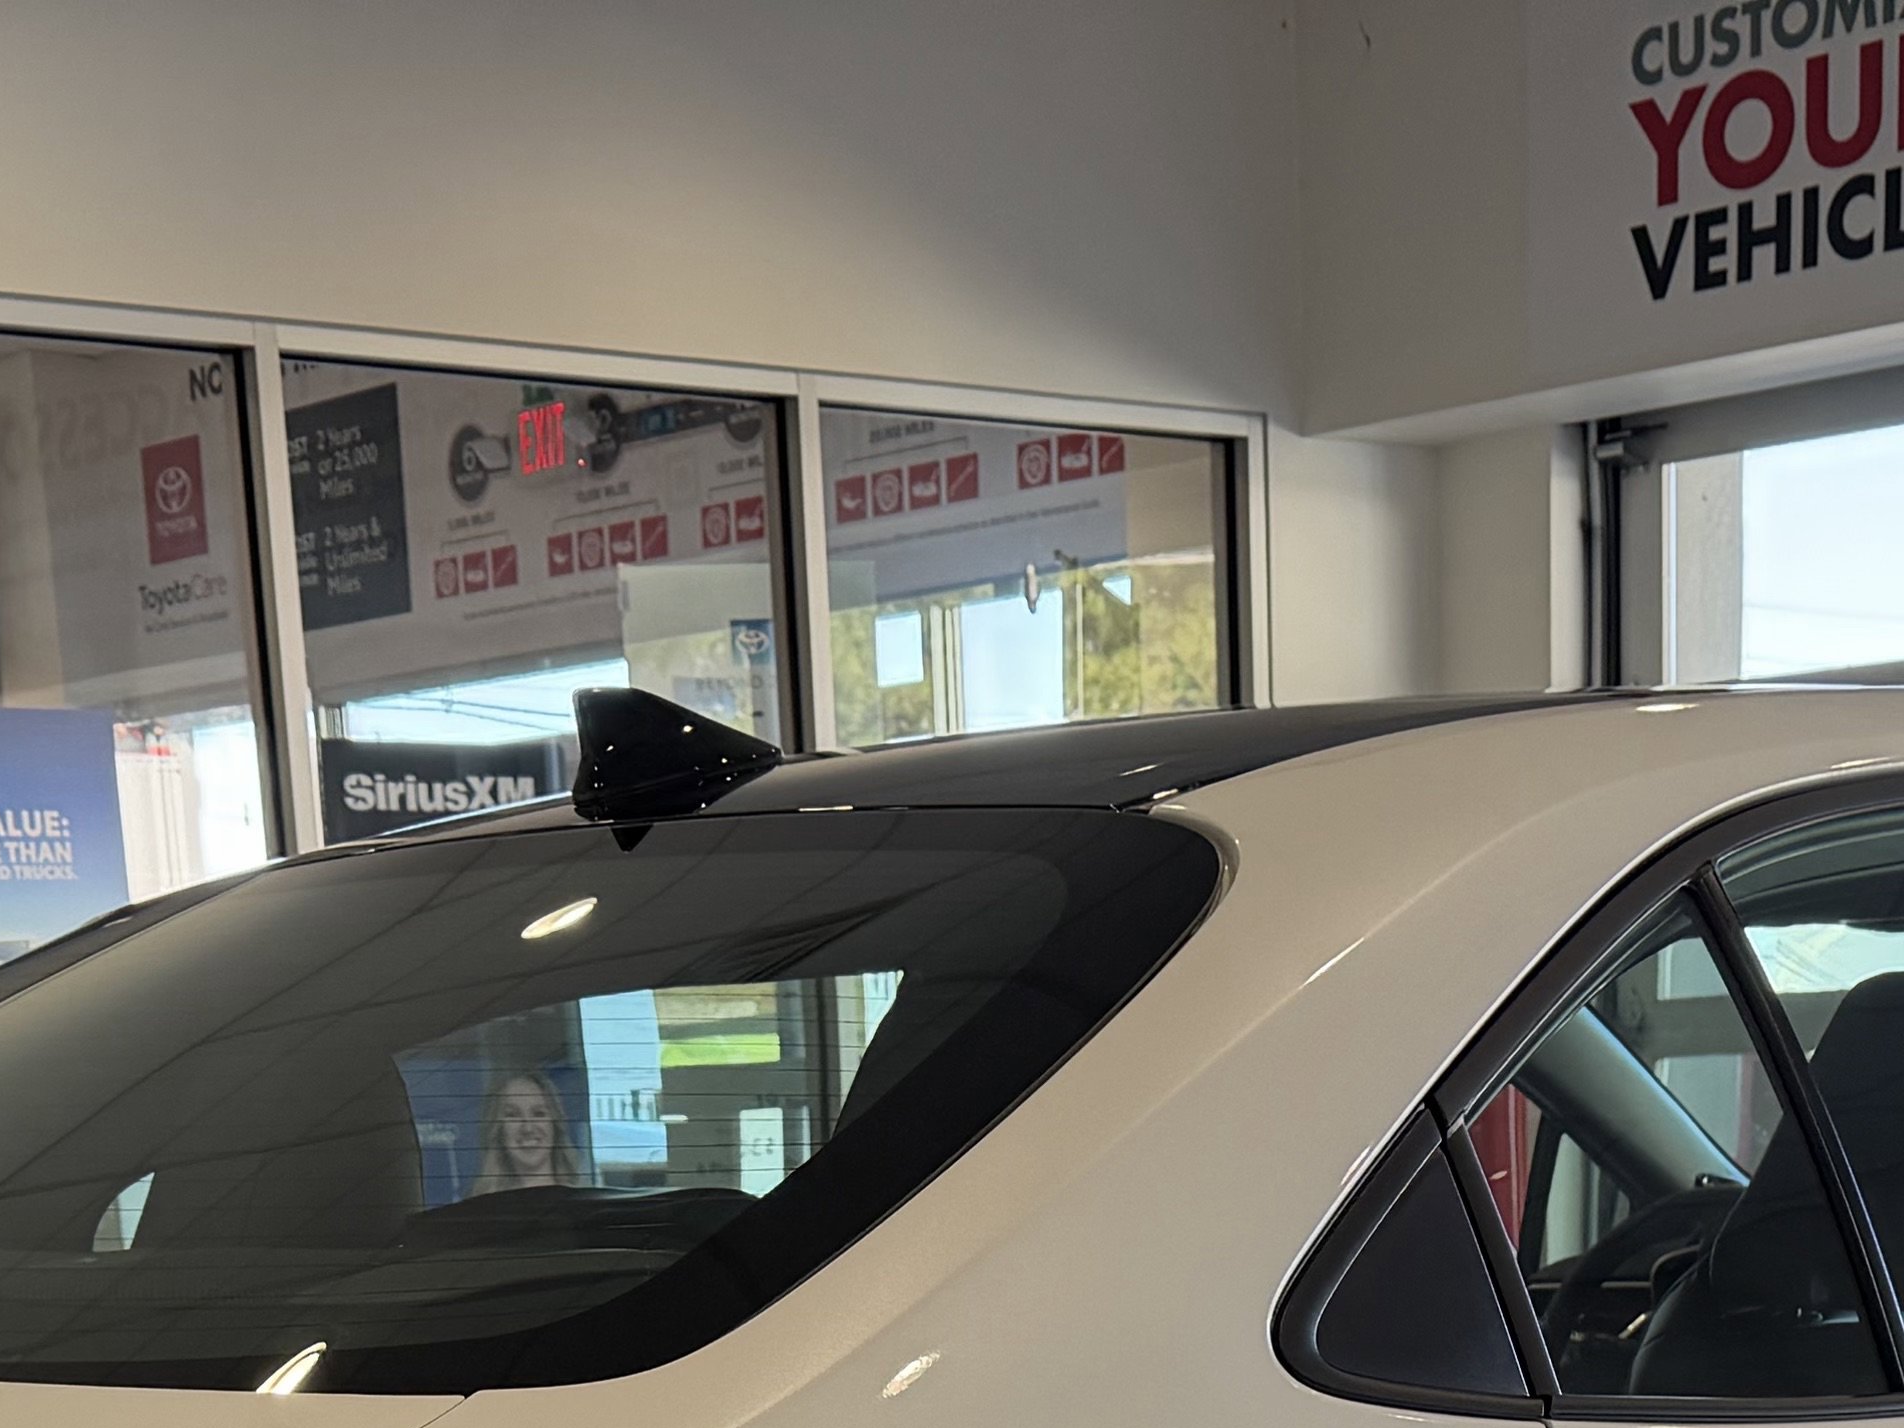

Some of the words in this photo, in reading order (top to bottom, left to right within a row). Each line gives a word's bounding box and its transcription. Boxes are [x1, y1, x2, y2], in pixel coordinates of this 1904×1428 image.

[518, 401, 566, 476] EXIT
[343, 773, 536, 813] SiriusXM
[6, 842, 73, 864] THAN
